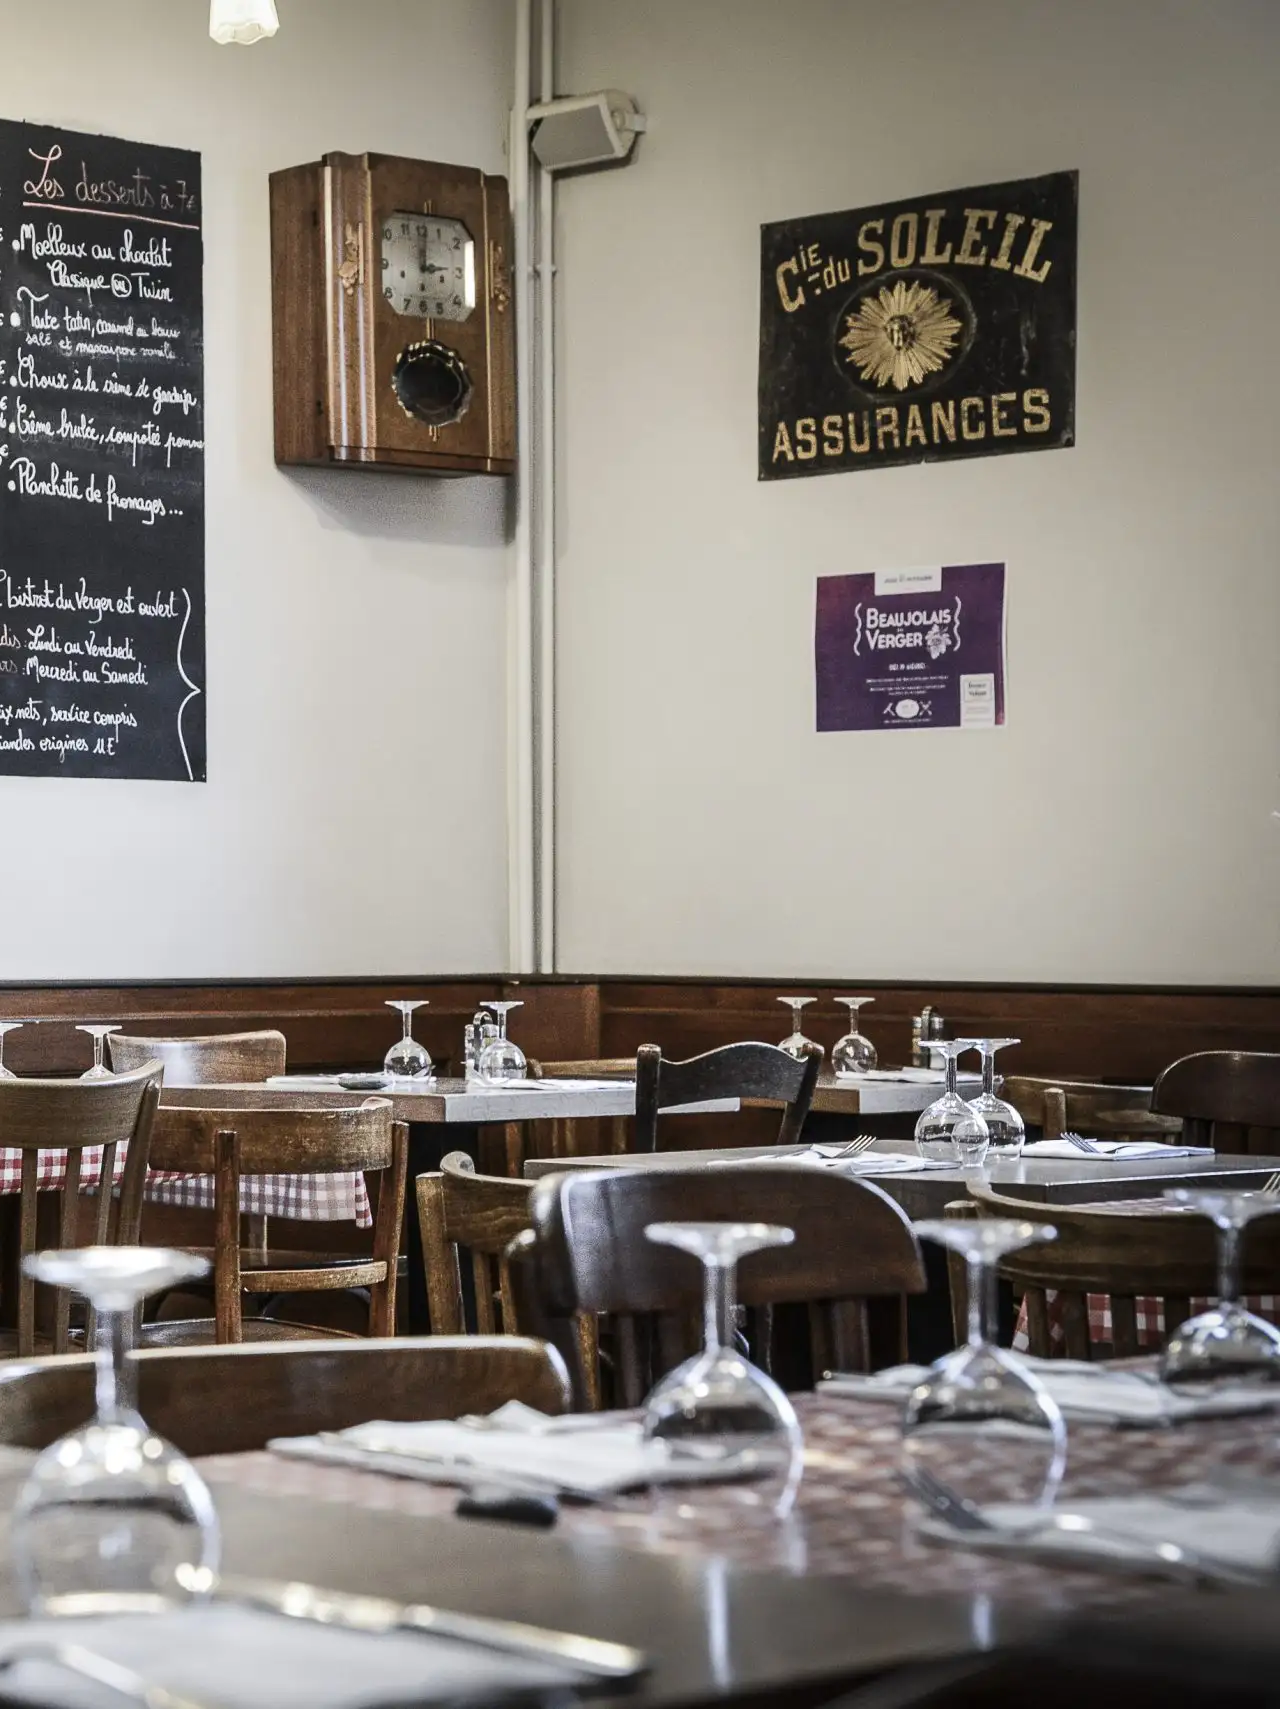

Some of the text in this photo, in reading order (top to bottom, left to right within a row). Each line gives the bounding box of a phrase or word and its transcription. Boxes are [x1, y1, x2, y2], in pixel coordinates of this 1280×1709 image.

[23, 144, 155, 207] Les desserts
[20, 222, 86, 259] Moelleux
[92, 245, 115, 260] au
[823, 208, 1053, 290] du SOLEIL
[46, 259, 110, 308] Classique
[772, 387, 1051, 463] ASSURANCES
[10, 457, 165, 525] Planchette de fromages
[7, 576, 54, 609] bistrot
[56, 583, 73, 611] du
[75, 577, 114, 623] Verger
[117, 586, 135, 613] est
[139, 590, 178, 617] ouvert
[26, 655, 148, 684] Mercredi au Samedi
[64, 642, 84, 655] au
[85, 631, 136, 661] Vendredi
[51, 704, 90, 723] service
[94, 703, 137, 742] compris
[40, 735, 89, 763] origines
